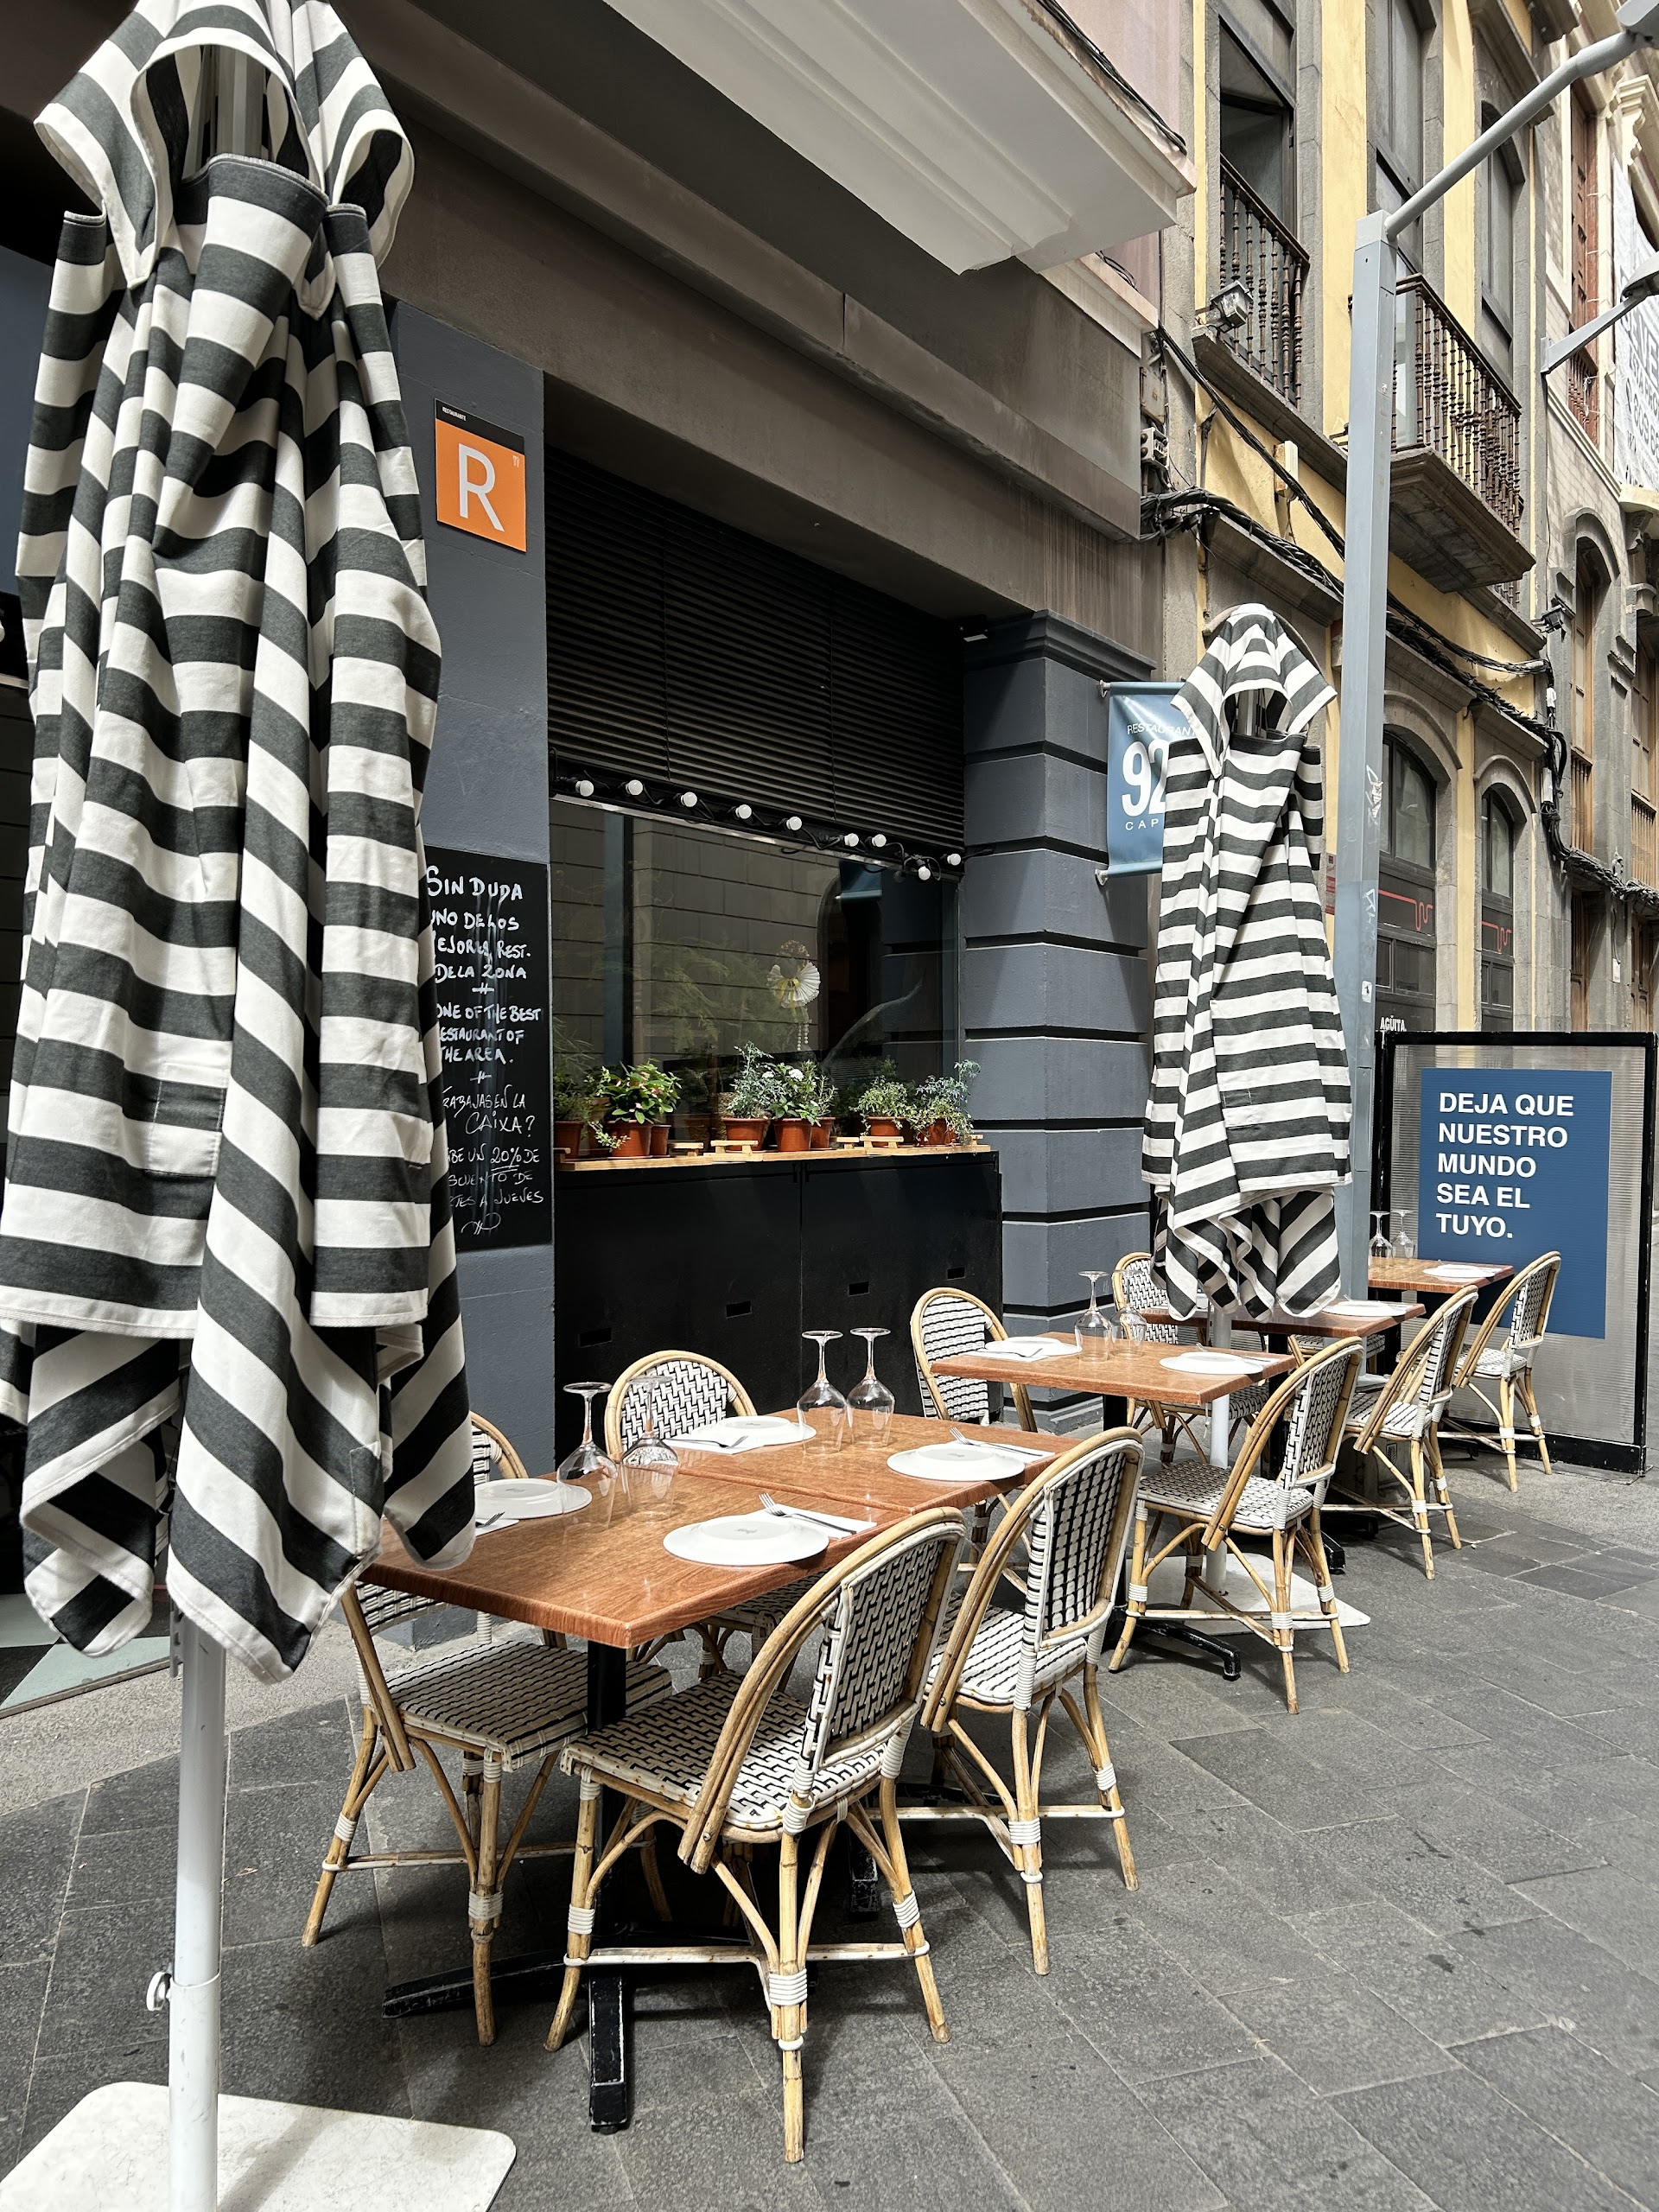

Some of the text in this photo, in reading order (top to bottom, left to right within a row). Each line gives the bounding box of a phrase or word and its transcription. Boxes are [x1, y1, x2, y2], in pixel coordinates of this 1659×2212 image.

[458, 442, 505, 532] R
[1127, 722, 1195, 737] RESTAURAN
[426, 865, 524, 903] SIN DUDA
[433, 931, 489, 957] EJORES
[481, 963, 527, 980] ZONA
[509, 1005, 542, 1023] BEST
[440, 1026, 524, 1045] ESTAURANT OF
[1439, 1092, 1574, 1116] DEJA QUE
[1438, 1122, 1568, 1148] NUESTRO
[1438, 1153, 1536, 1178] MUNDO
[1436, 1182, 1530, 1209] SEA EL
[1435, 1212, 1513, 1239] TUYO.
